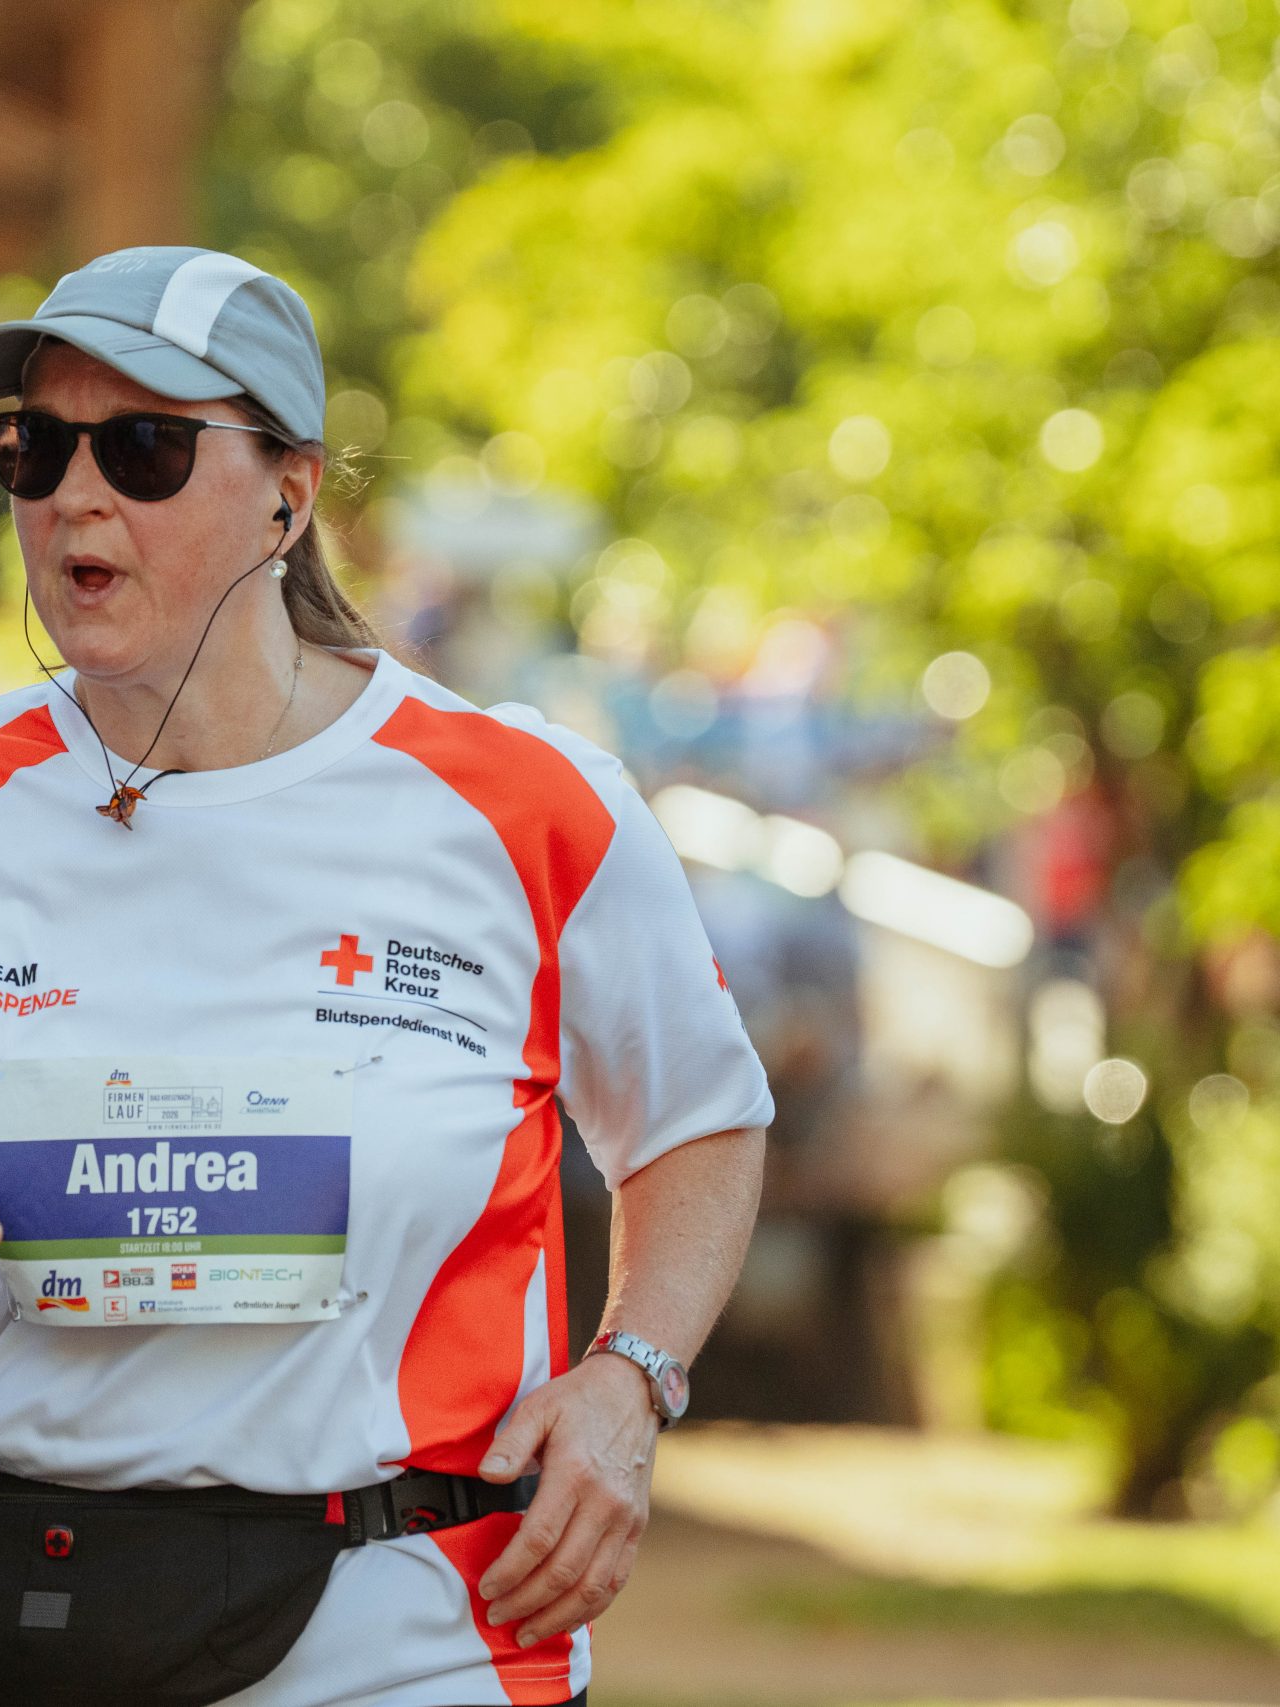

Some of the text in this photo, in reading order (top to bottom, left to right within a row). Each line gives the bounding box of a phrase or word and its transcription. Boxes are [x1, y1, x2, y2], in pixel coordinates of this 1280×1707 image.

[387, 940, 484, 976] Deutsches
[386, 959, 441, 981] Rotes
[384, 977, 439, 1000] Kreuz
[316, 1008, 487, 1058] Blutspendedienst West
[110, 1069, 129, 1081] dm
[108, 1092, 145, 1103] FIRMEN
[108, 1104, 144, 1119] LAUF
[66, 1142, 258, 1195] Andrea
[127, 1207, 197, 1235] 1752
[42, 1269, 82, 1297] dm
[122, 1276, 155, 1287] 88.3
[209, 1269, 302, 1281] BIONTECH
